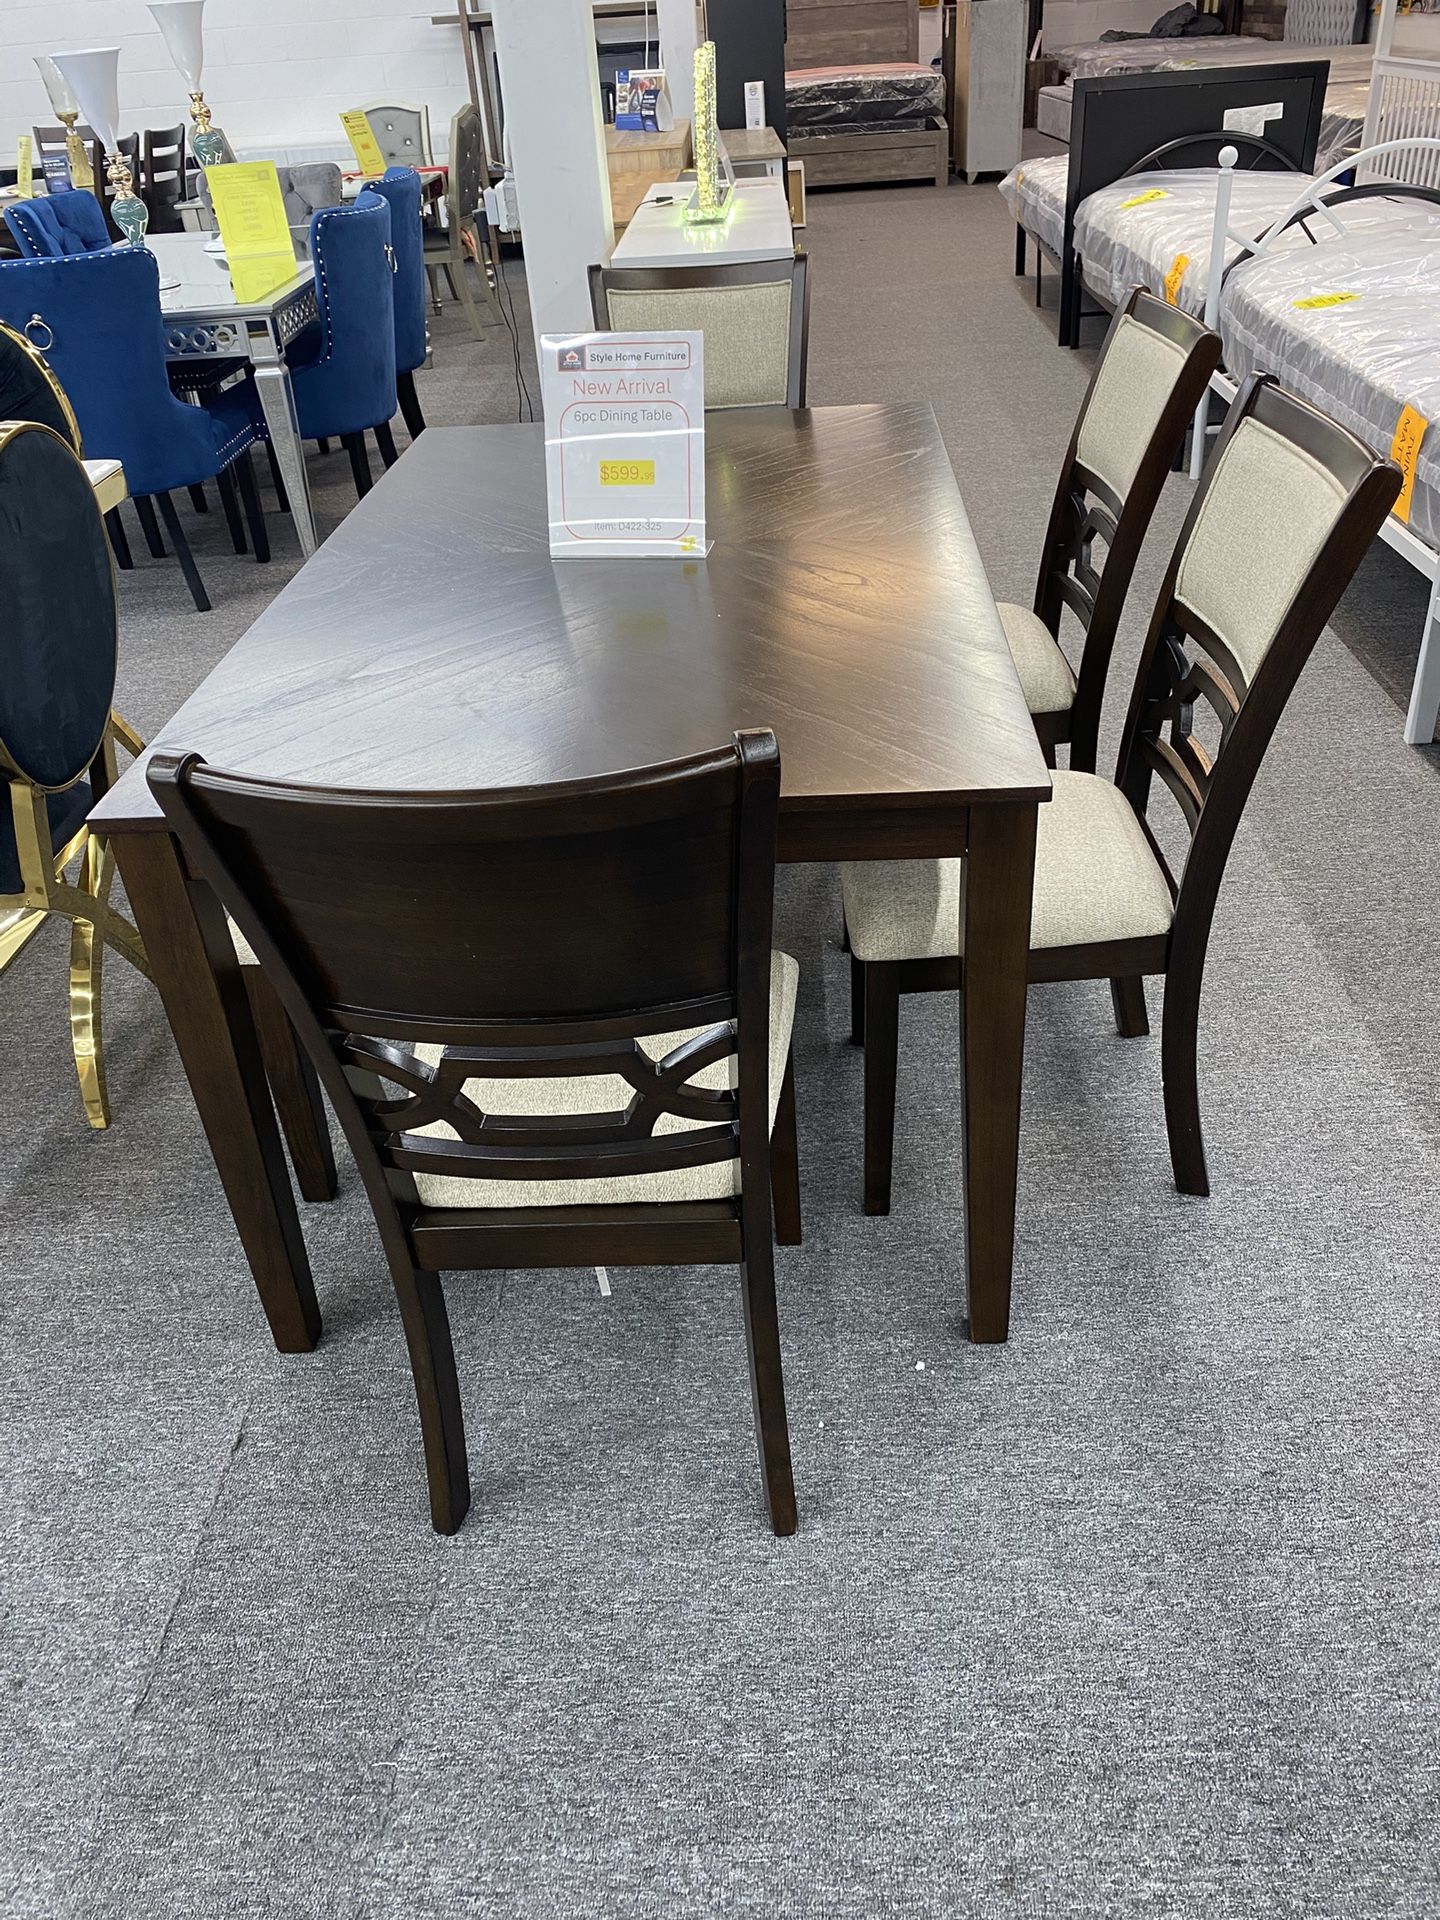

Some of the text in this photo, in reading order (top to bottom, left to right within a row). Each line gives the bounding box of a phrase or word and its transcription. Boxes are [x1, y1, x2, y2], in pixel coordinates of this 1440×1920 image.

[590, 352, 686, 363] Style Home Furniture
[573, 378, 672, 396] New Arrival
[574, 409, 672, 424] 6pc Dining Table
[1402, 436, 1416, 477] TWIN
[618, 522, 662, 531] D422-325
